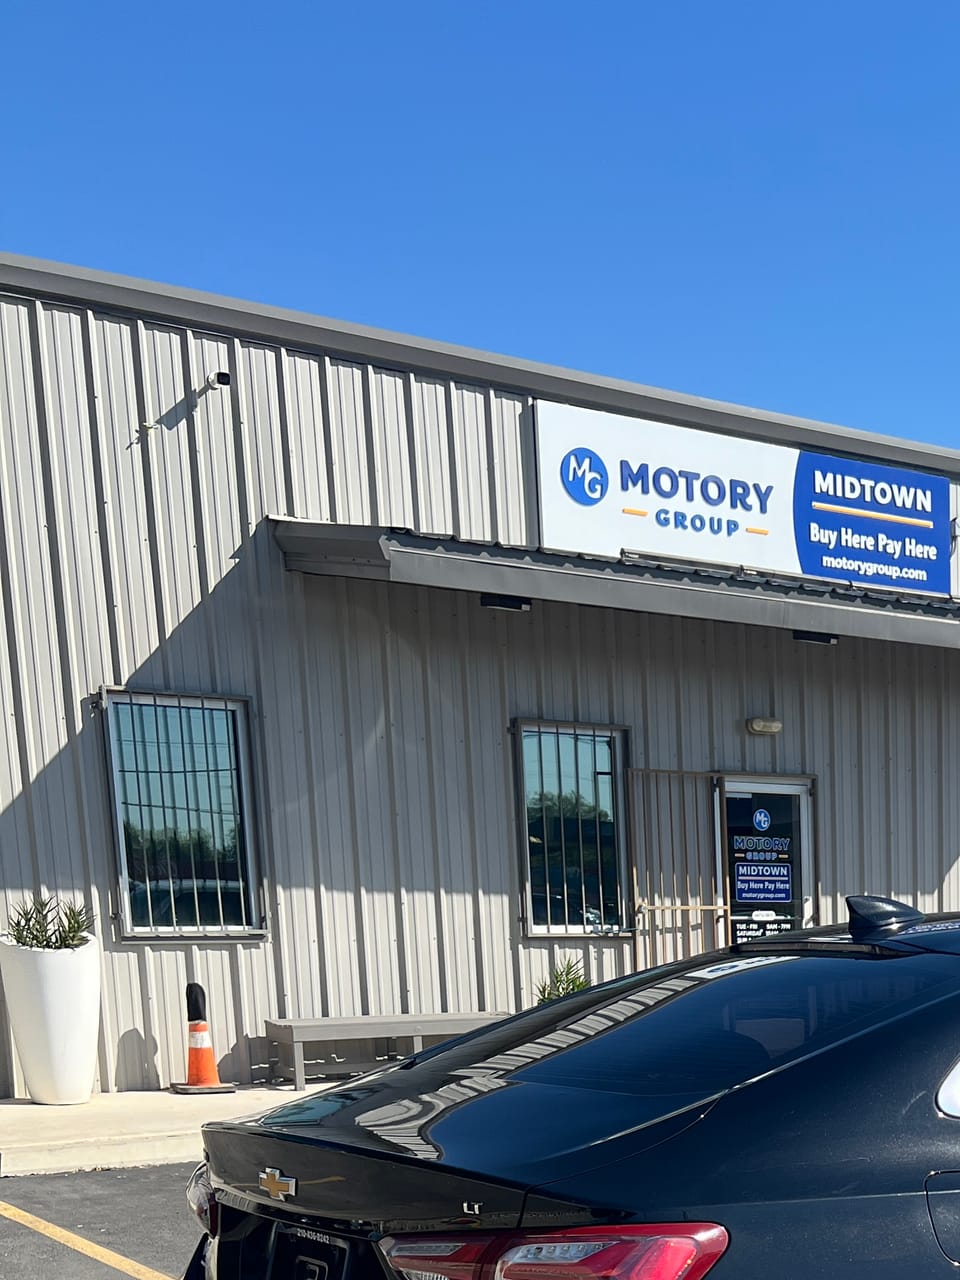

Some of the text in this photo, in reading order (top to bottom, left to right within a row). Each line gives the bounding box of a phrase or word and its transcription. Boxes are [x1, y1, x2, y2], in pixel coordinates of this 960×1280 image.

[569, 454, 603, 499] MG
[619, 459, 774, 514] MOTORY
[814, 470, 932, 512] MIDTOWN
[655, 508, 740, 536] GROUP
[809, 522, 938, 560] Buy Here Pay Here
[822, 556, 928, 581] motorygroup.com
[733, 835, 790, 850] MOTORY
[745, 851, 778, 860] GROUP
[738, 866, 788, 876] MIDTOWN
[737, 881, 790, 890] Buy Here Pay Here
[463, 1202, 483, 1214] LT
